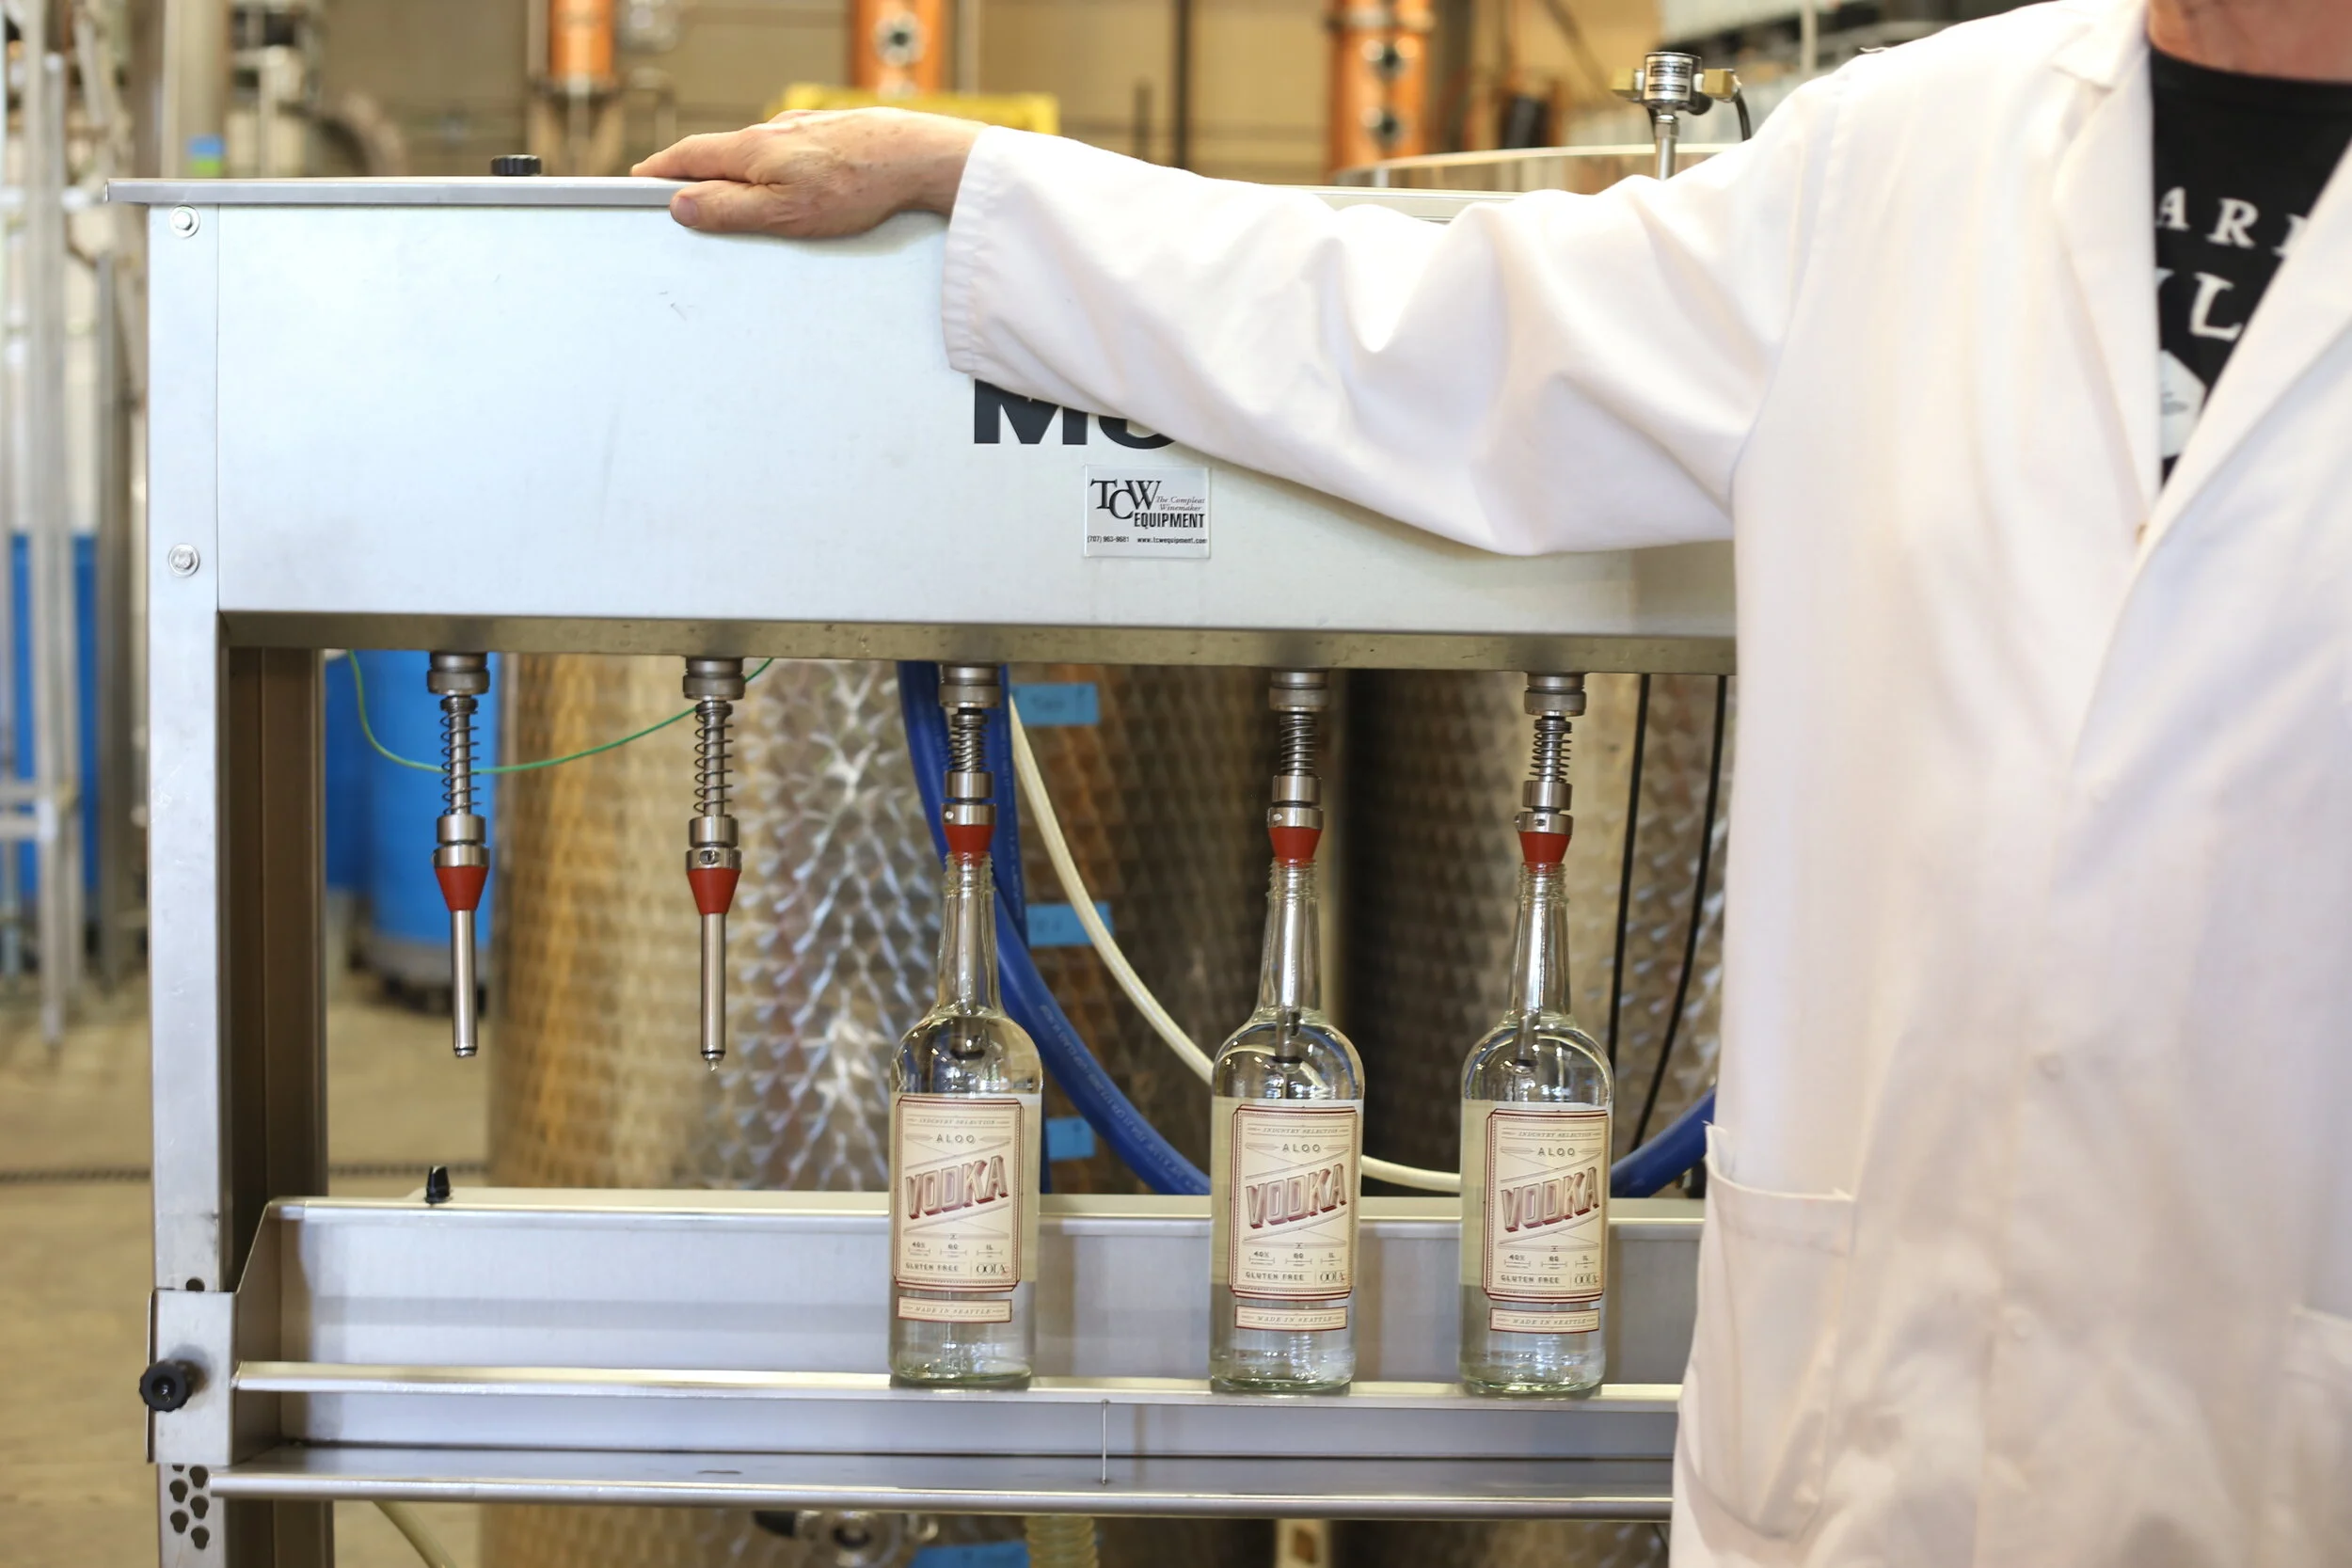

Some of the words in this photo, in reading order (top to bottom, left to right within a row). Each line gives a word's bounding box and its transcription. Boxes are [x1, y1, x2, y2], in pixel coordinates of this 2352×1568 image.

[2155, 267, 2243, 341] L
[974, 378, 1176, 450] M
[1089, 478, 1162, 520] TCW
[1134, 513, 1205, 529] EQUIPMENT
[905, 1155, 1009, 1220] VODKA
[1245, 1163, 1347, 1229] VODKA
[1500, 1166, 1599, 1232] VODKA
[905, 1261, 934, 1271] GLUTEN
[1246, 1271, 1279, 1280] GLUTEN
[1282, 1272, 1305, 1280] FREE
[1501, 1275, 1534, 1283] GLUTEN
